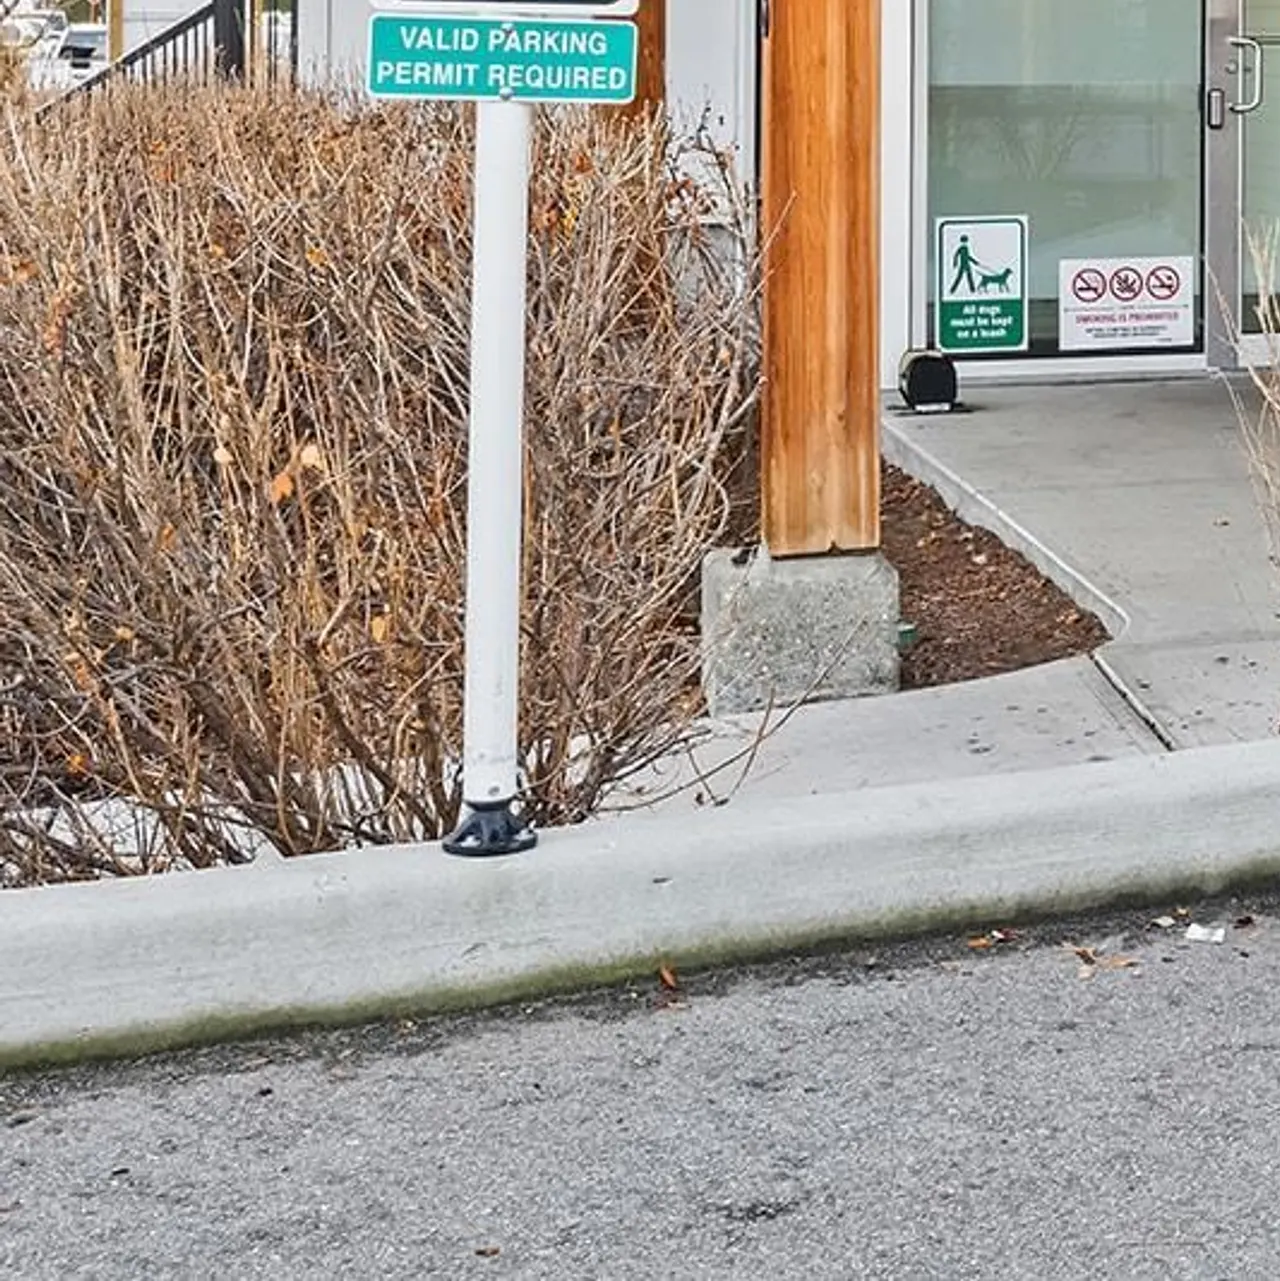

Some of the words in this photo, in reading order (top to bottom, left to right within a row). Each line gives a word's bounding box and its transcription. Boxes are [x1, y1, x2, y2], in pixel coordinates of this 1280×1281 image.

[400, 26, 479, 52] VALID
[489, 28, 608, 55] PARKING
[377, 61, 478, 87] PERMIT
[488, 63, 627, 92] REQUIRED
